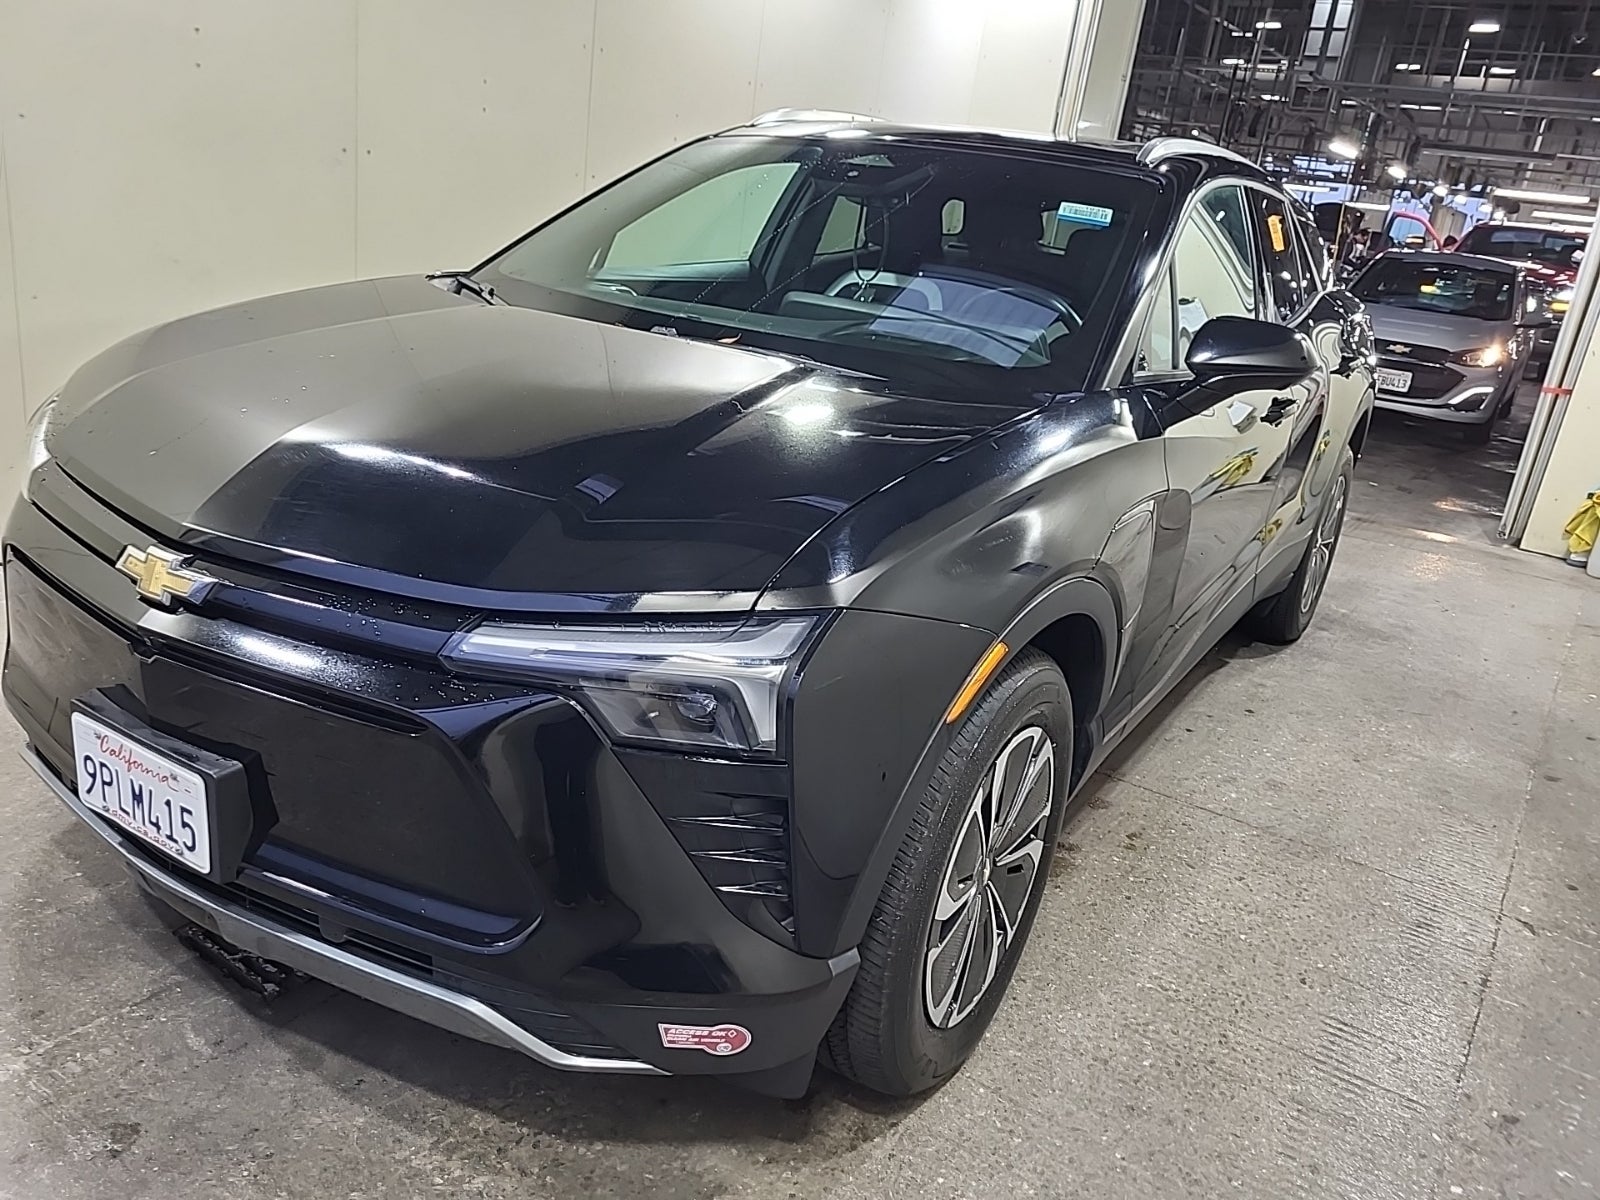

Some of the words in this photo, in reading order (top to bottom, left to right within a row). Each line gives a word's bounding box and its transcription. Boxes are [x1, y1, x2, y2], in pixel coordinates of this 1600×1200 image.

[100, 734, 179, 792] California
[83, 754, 197, 853] 9PLM415
[668, 1028, 710, 1036] ACCESS
